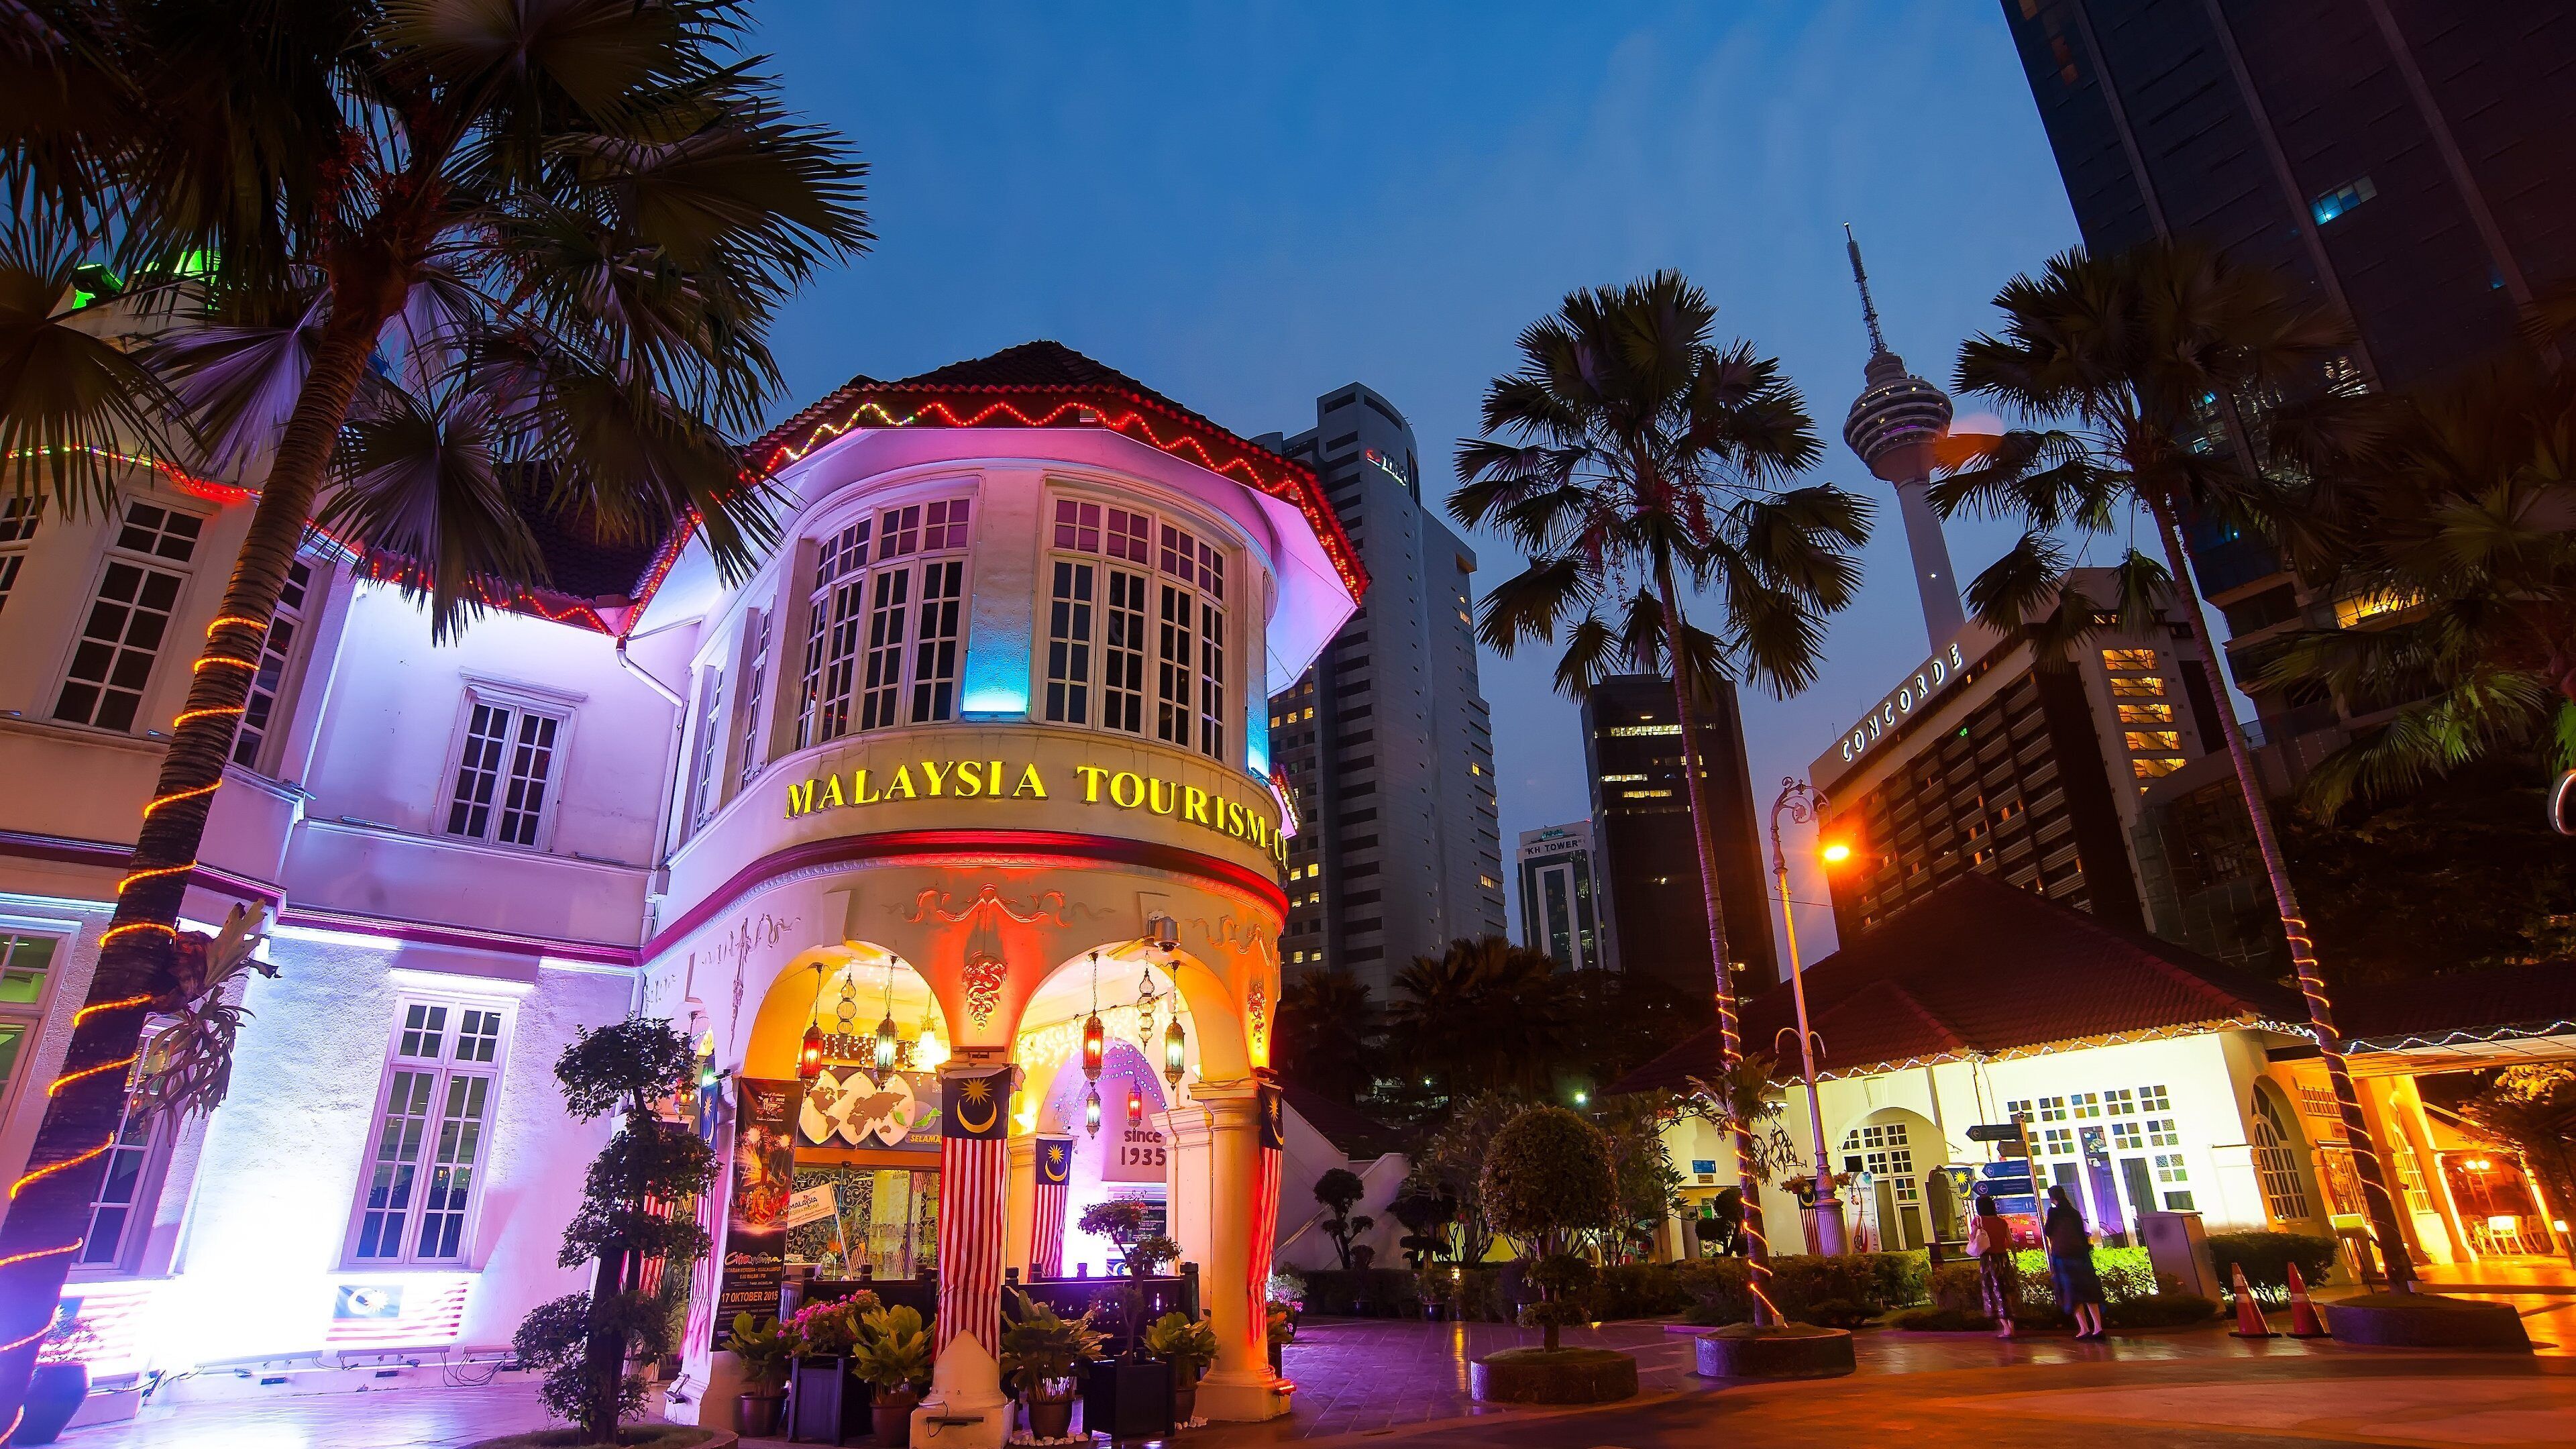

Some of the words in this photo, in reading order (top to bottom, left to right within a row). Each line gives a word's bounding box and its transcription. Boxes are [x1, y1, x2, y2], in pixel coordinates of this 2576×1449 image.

[1841, 644, 1962, 761] CONCORDE
[784, 760, 1049, 819] MALAYSIA
[1076, 765, 1267, 849] TOURISM
[910, 1134, 942, 1143] SELAMA
[1124, 1130, 1162, 1143] since
[1121, 1146, 1166, 1167] 1935
[722, 1293, 730, 1303] 17
[731, 1291, 763, 1303] OKTOBER
[763, 1291, 779, 1301] 2015
